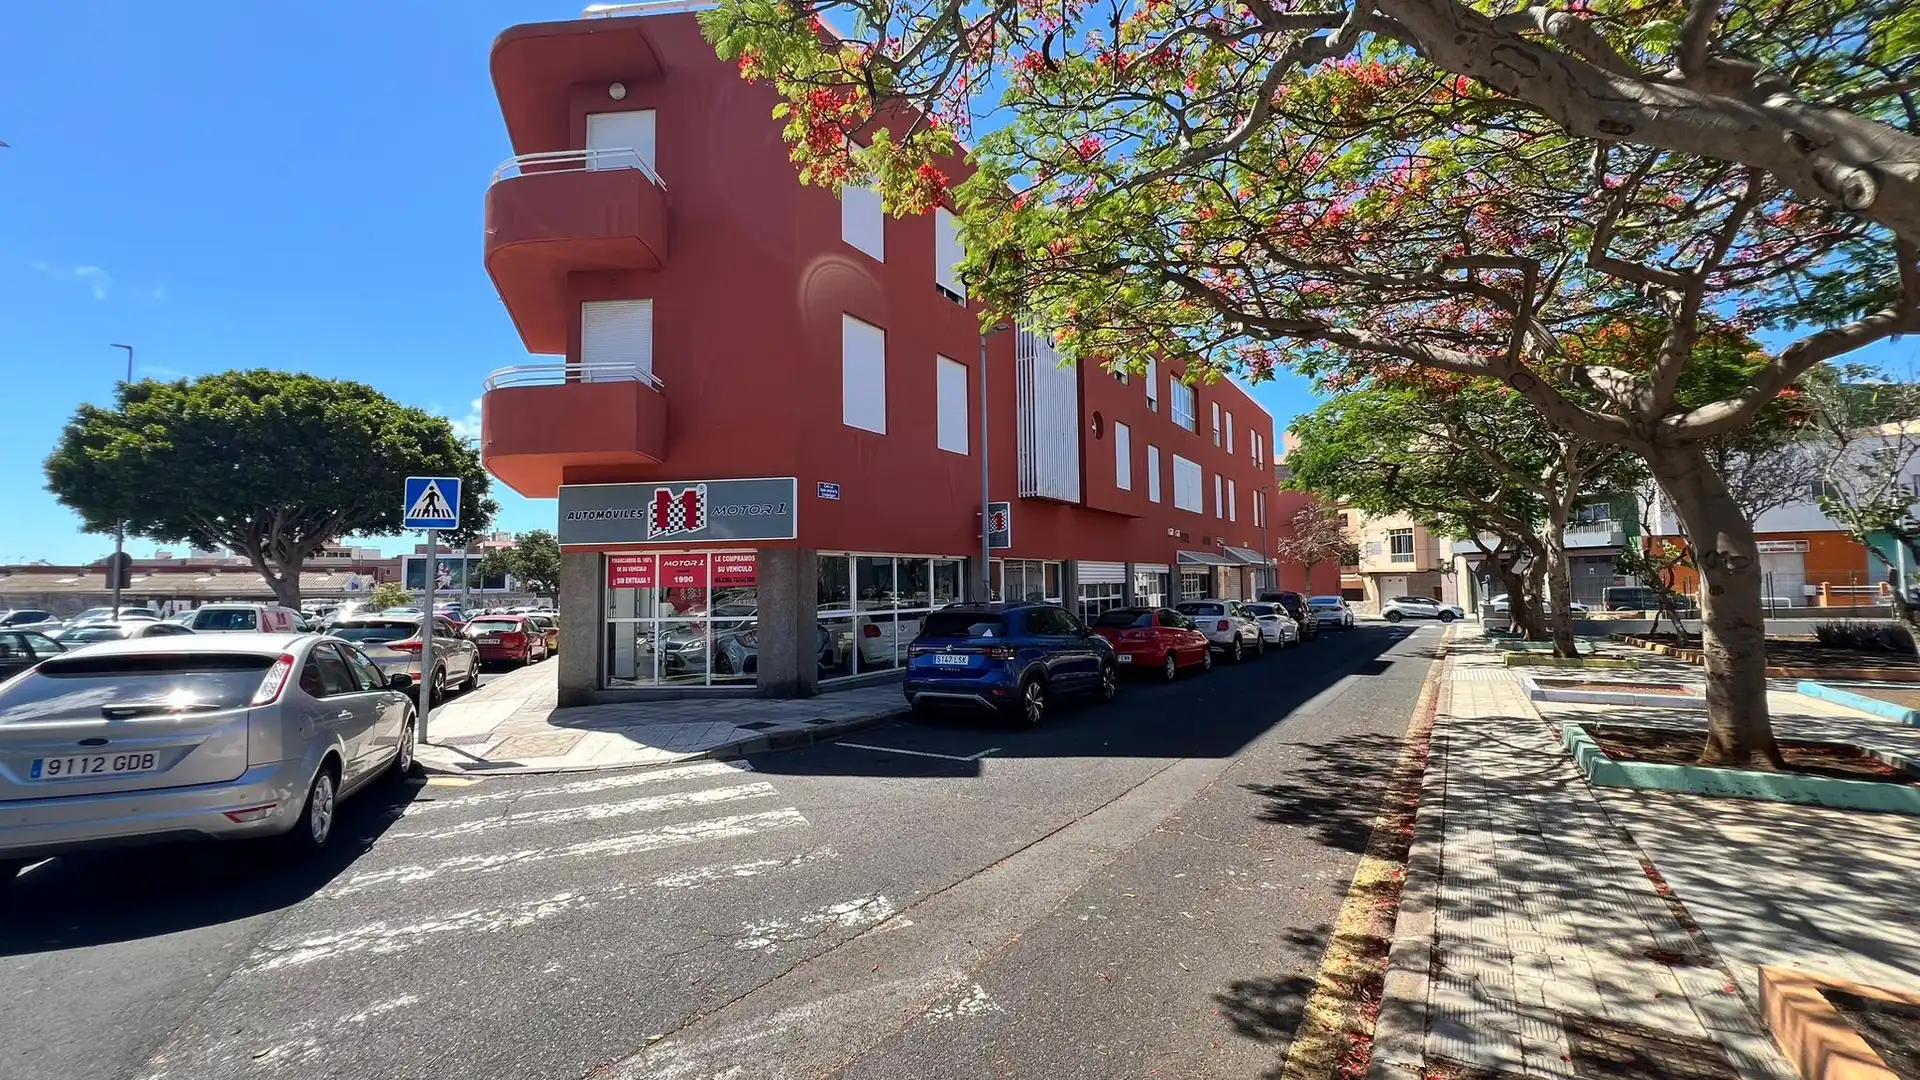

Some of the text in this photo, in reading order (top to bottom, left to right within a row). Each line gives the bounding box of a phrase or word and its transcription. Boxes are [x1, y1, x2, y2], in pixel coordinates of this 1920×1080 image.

[711, 502, 787, 517] MOTOR 1
[567, 508, 644, 521] AUTOMÓVILES
[698, 559, 705, 567] 1
[714, 555, 721, 563] LE
[726, 564, 753, 573] VEHÍCULO
[673, 575, 694, 583] 1990
[47, 754, 154, 775] 9112 GDB
